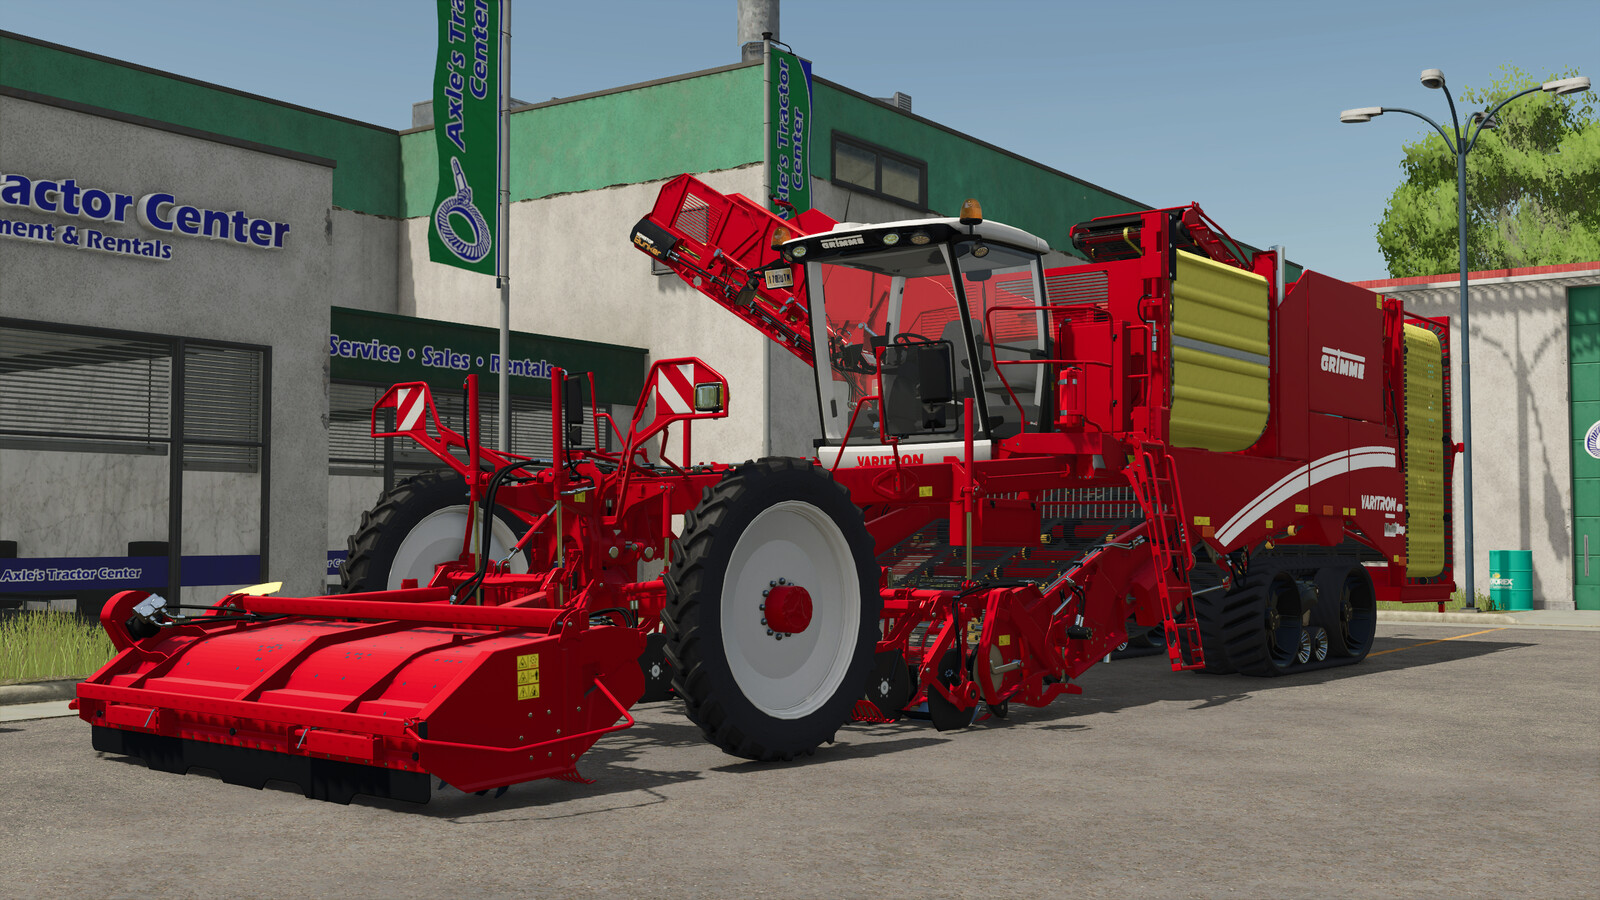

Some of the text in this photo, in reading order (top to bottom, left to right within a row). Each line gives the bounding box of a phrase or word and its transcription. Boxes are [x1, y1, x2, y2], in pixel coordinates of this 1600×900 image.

[469, 0, 489, 100] Center
[445, 50, 466, 153] Axle's
[777, 58, 790, 149] Tractor
[792, 107, 804, 191] Center
[145, 193, 290, 248] Center
[62, 225, 79, 246] &
[87, 229, 172, 260] Rentals
[820, 234, 865, 249] GRIMME
[330, 334, 401, 363] Service
[422, 345, 470, 371] Sales
[1321, 346, 1366, 380] GRIMME
[1361, 494, 1397, 512] VARITRON
[0, 566, 142, 582] Axle's Tractor Center
